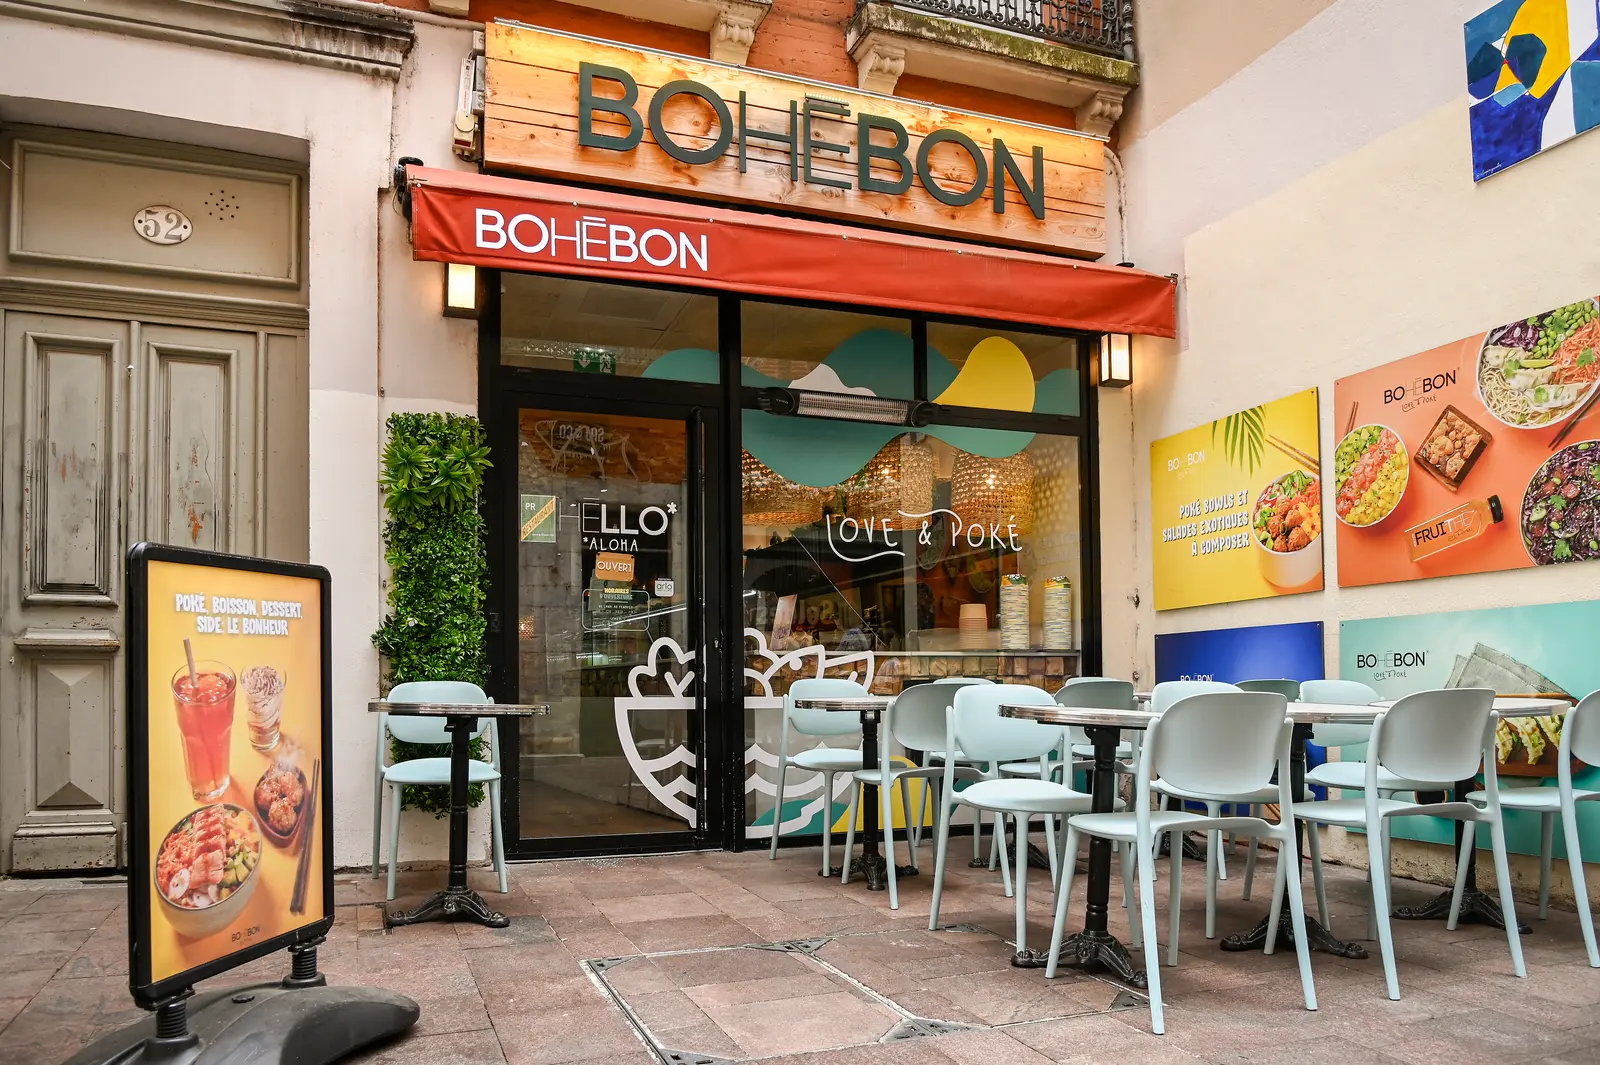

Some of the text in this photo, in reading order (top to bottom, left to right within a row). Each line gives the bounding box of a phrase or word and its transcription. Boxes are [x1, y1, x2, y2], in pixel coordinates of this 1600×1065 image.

[143, 209, 183, 241] 52
[525, 502, 536, 511] PR
[1180, 489, 1249, 519] POKÉ BOWLS ET
[825, 508, 1023, 563] LOVE & POKÉ
[1163, 511, 1249, 543] SALADES EXOTIQUES
[1191, 531, 1250, 557] À COMPOSER
[227, 616, 240, 634] LE
[242, 617, 289, 636] BONHEUR
